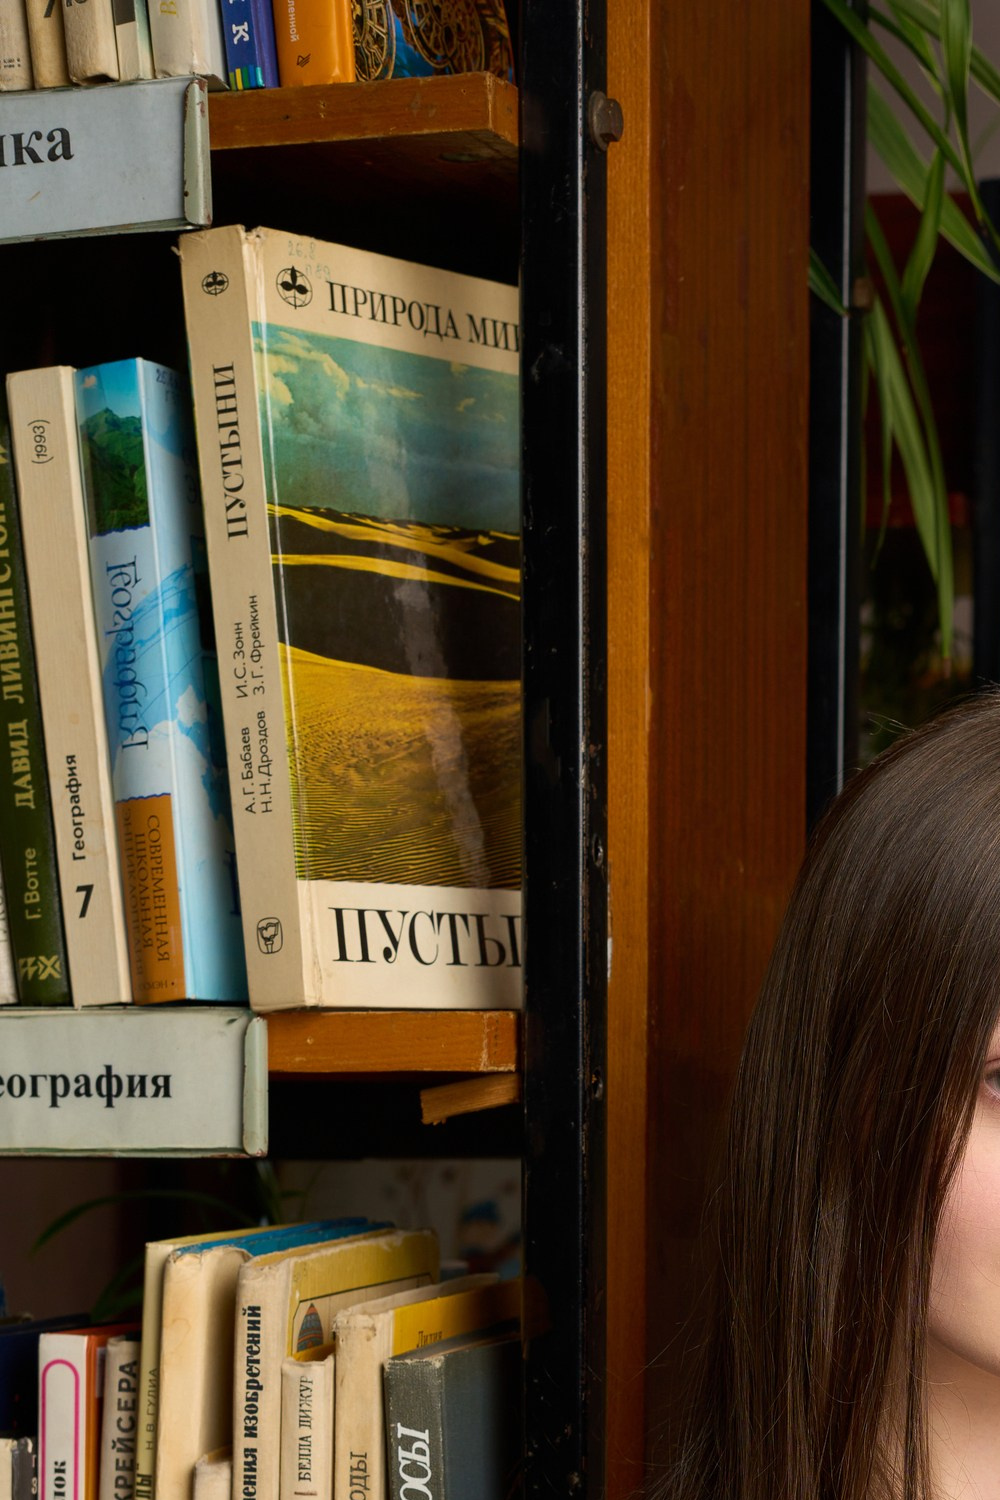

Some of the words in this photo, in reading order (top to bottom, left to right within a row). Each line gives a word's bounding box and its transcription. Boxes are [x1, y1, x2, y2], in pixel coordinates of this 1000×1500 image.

[326, 280, 461, 342] ПРИРОДА
[27, 419, 54, 464] (1993)
[212, 361, 249, 541] ПУСТЫНИ
[105, 555, 149, 750] География
[9, 719, 36, 809] ДАВИД
[65, 754, 86, 861] География
[24, 847, 41, 905] Вотте
[75, 884, 94, 919] 7
[134, 832, 154, 949] ШКОЛЬНАЯ
[147, 814, 170, 962] СОВРЕМЕННАЯ
[242, 1305, 263, 1438] изобретений
[298, 1375, 314, 1429] ДИЖУР
[298, 1435, 312, 1482] БЕЛЛА
